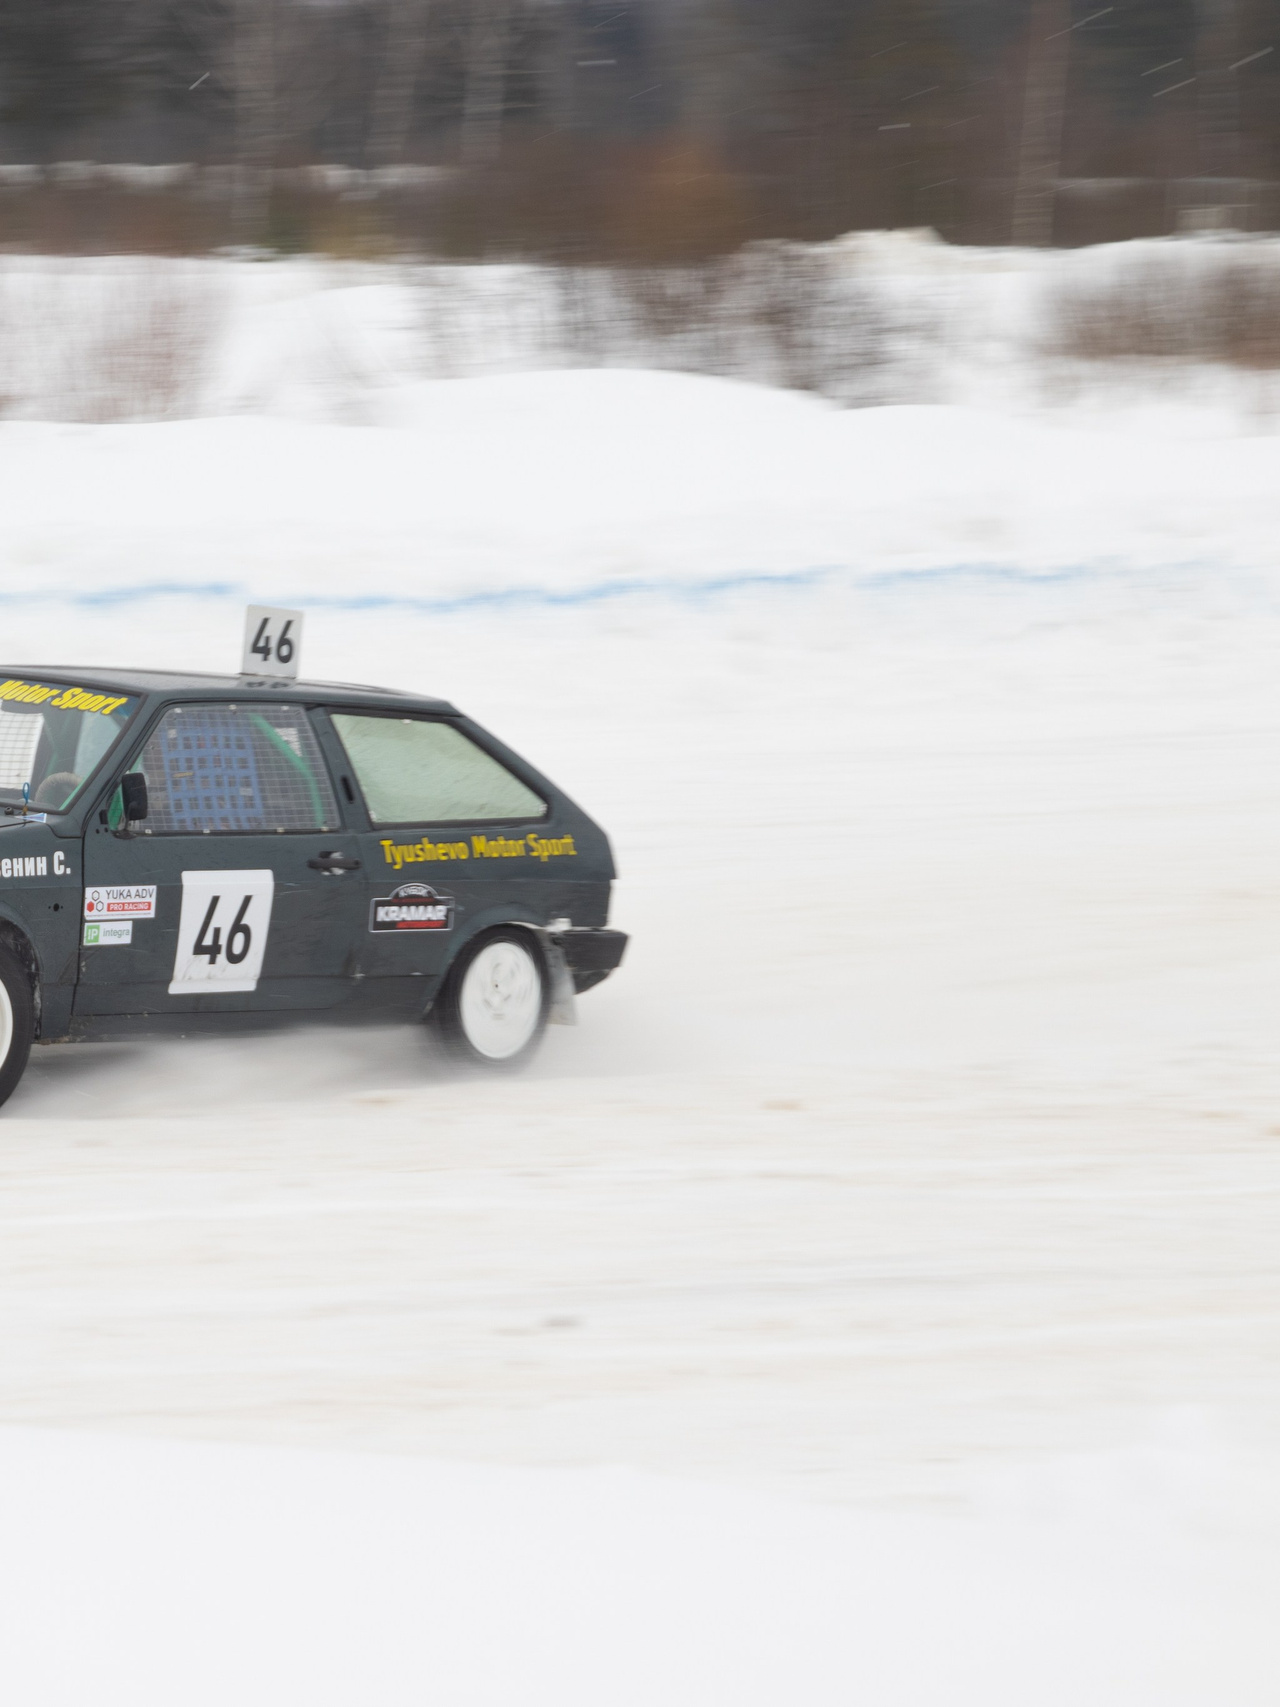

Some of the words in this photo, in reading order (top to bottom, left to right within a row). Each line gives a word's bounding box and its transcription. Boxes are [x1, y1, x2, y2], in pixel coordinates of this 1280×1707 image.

[250, 617, 294, 664] 46
[50, 687, 128, 714] Sport
[380, 837, 469, 870] Tyushevo
[470, 835, 526, 858] Motor
[526, 833, 577, 862] Sport
[105, 889, 133, 900] YUKA
[133, 888, 155, 899] ADV
[109, 903, 123, 911] PRO
[124, 902, 149, 910] RACING
[376, 905, 448, 921] KRAMAR
[88, 928, 99, 940] IP
[103, 928, 130, 939] integra
[192, 895, 253, 965] 46
